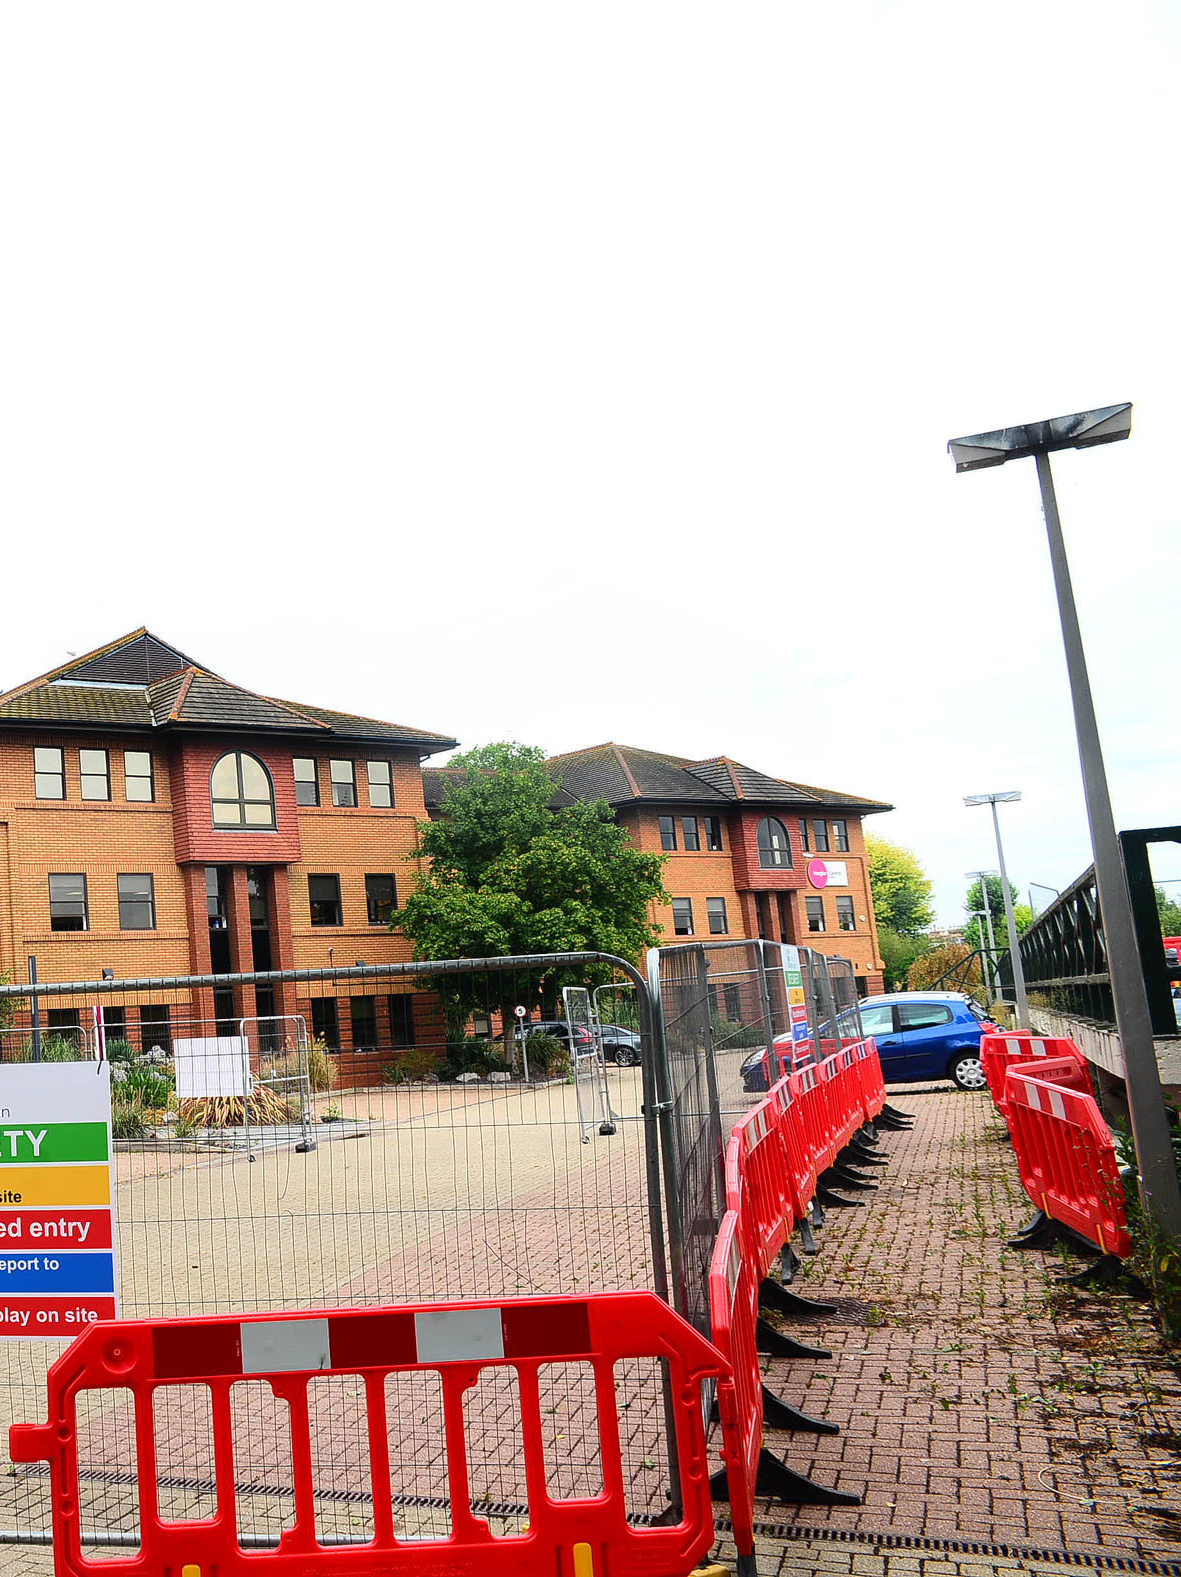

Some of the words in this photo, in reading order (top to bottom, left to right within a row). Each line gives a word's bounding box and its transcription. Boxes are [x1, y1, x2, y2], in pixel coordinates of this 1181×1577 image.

[28, 1217, 91, 1242] entry
[42, 1257, 60, 1271] to
[35, 1309, 60, 1323] on
[64, 1306, 98, 1323] site
